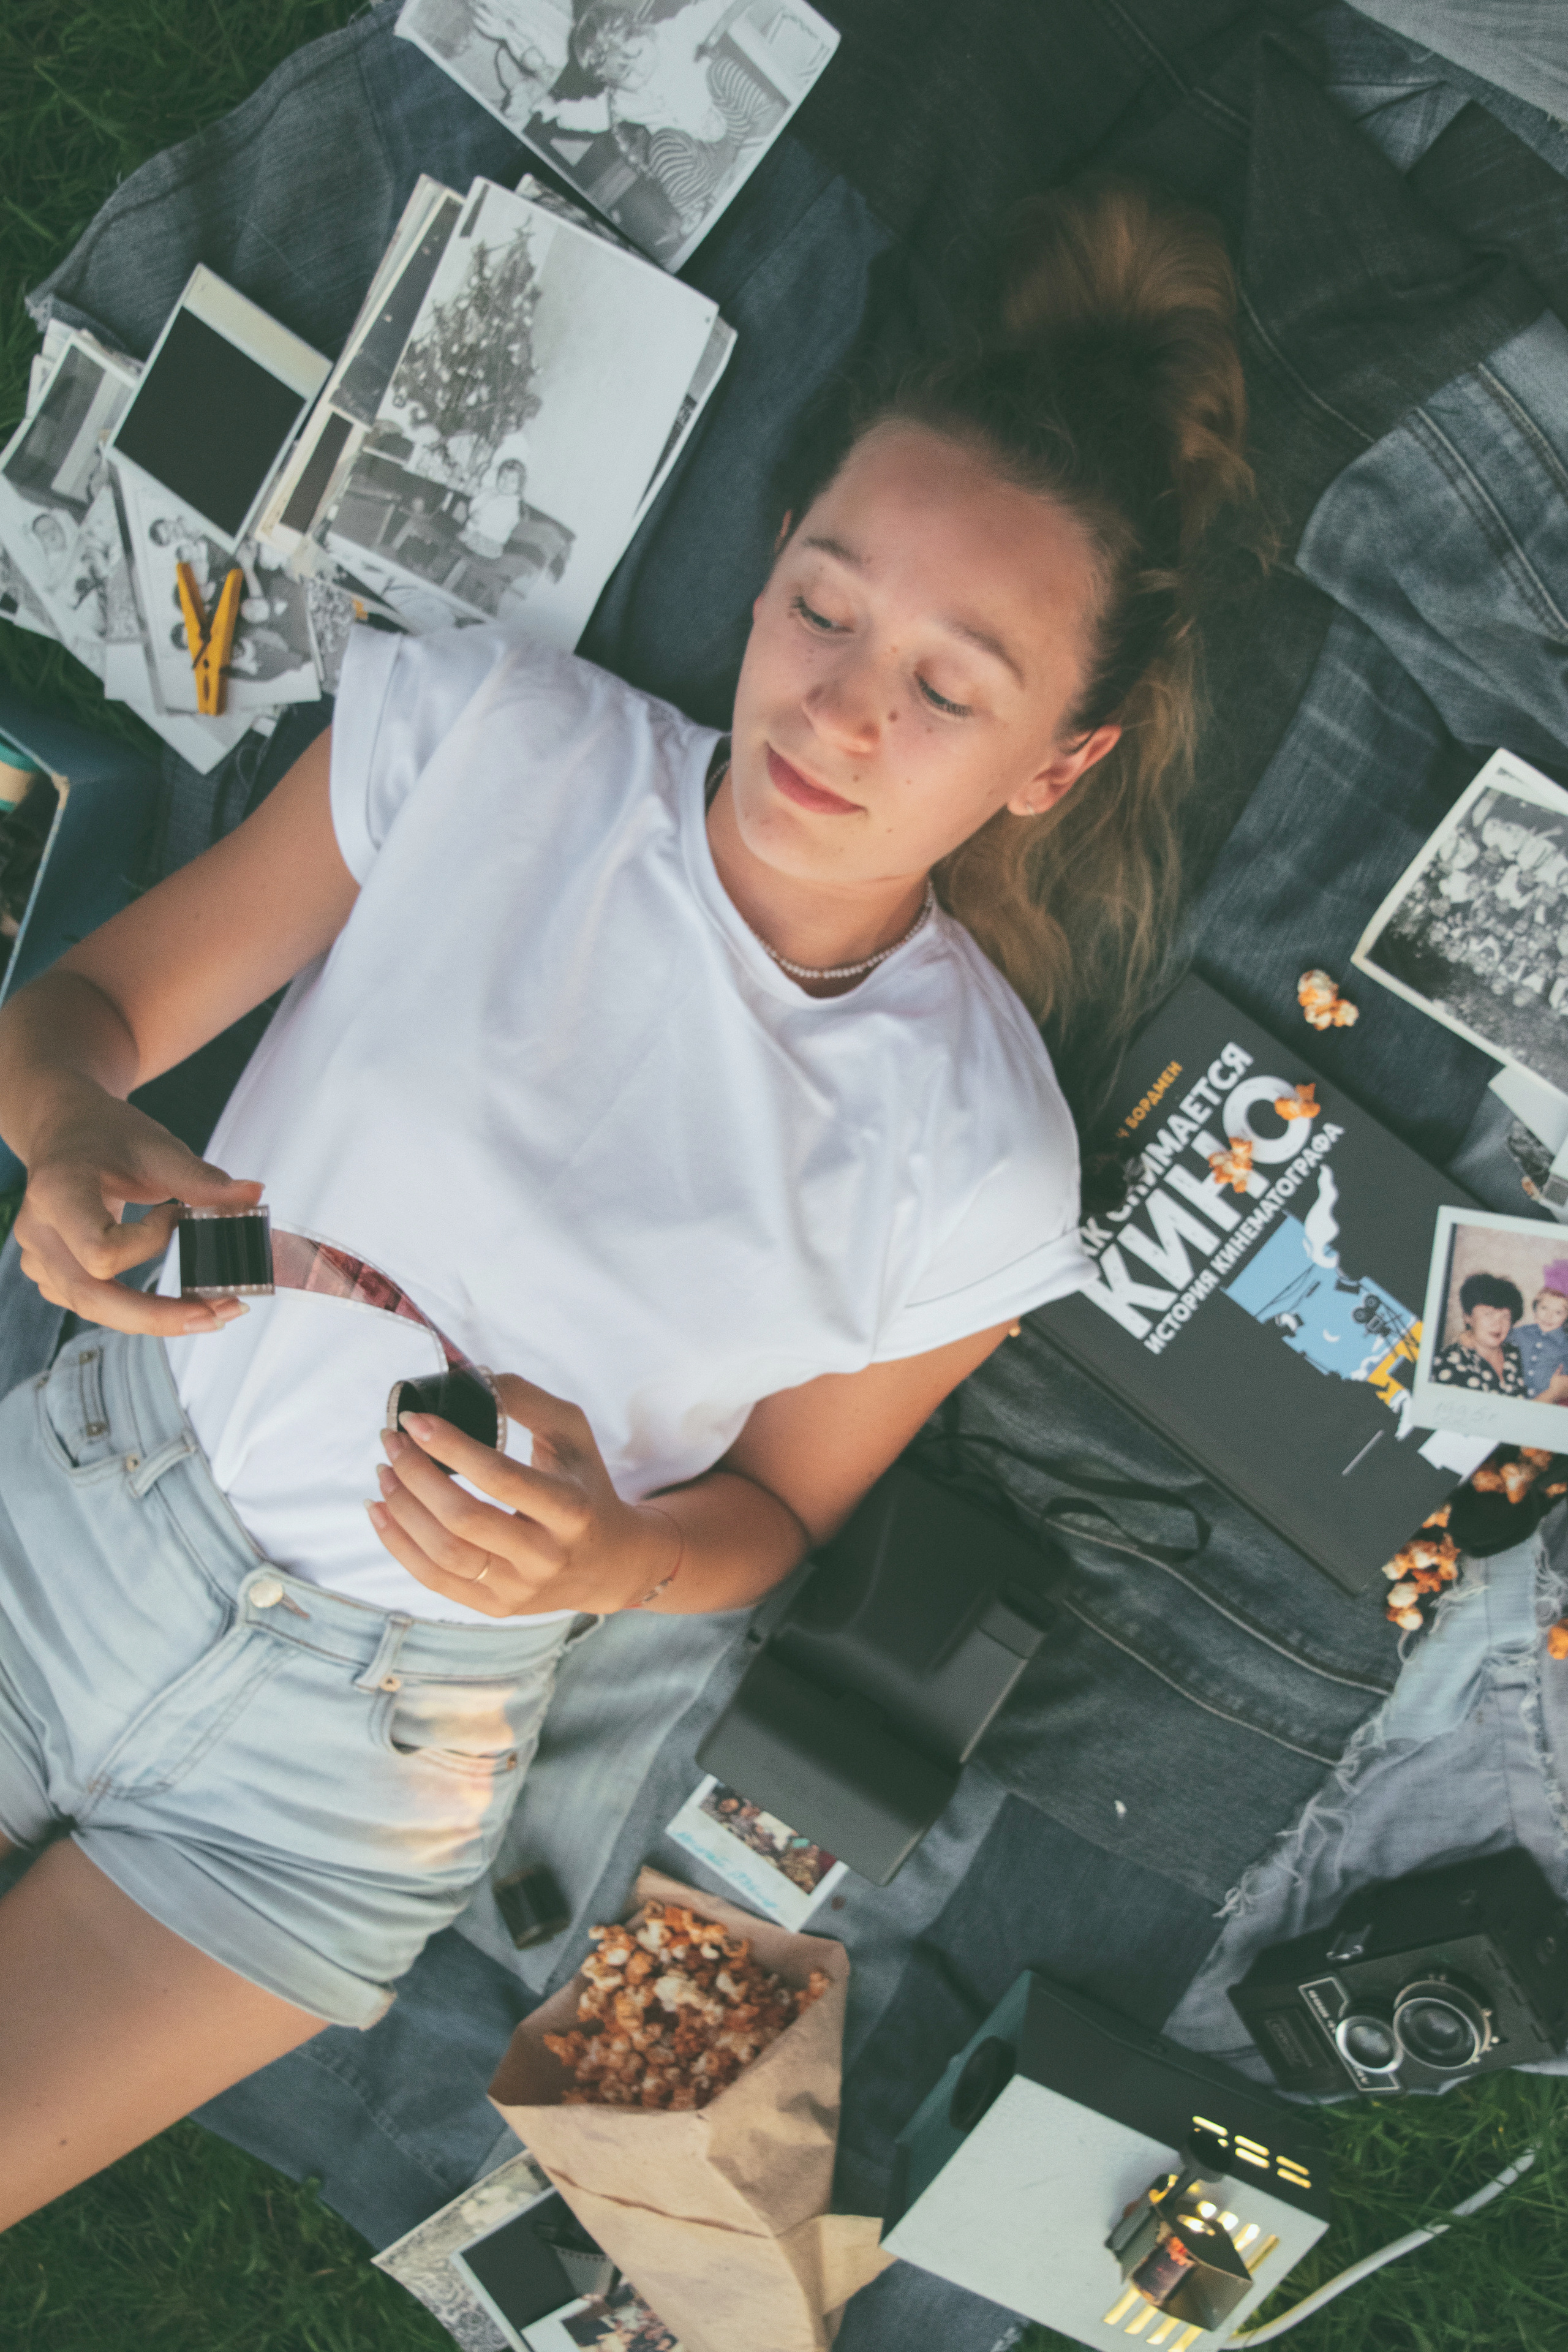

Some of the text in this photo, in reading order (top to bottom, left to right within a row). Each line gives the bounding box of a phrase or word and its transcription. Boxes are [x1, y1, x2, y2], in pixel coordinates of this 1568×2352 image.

[1080, 1075, 1312, 1340] КИНО
[1143, 1122, 1344, 1355] ИСТОРИЯ КИНЕМАТОГРАФА
